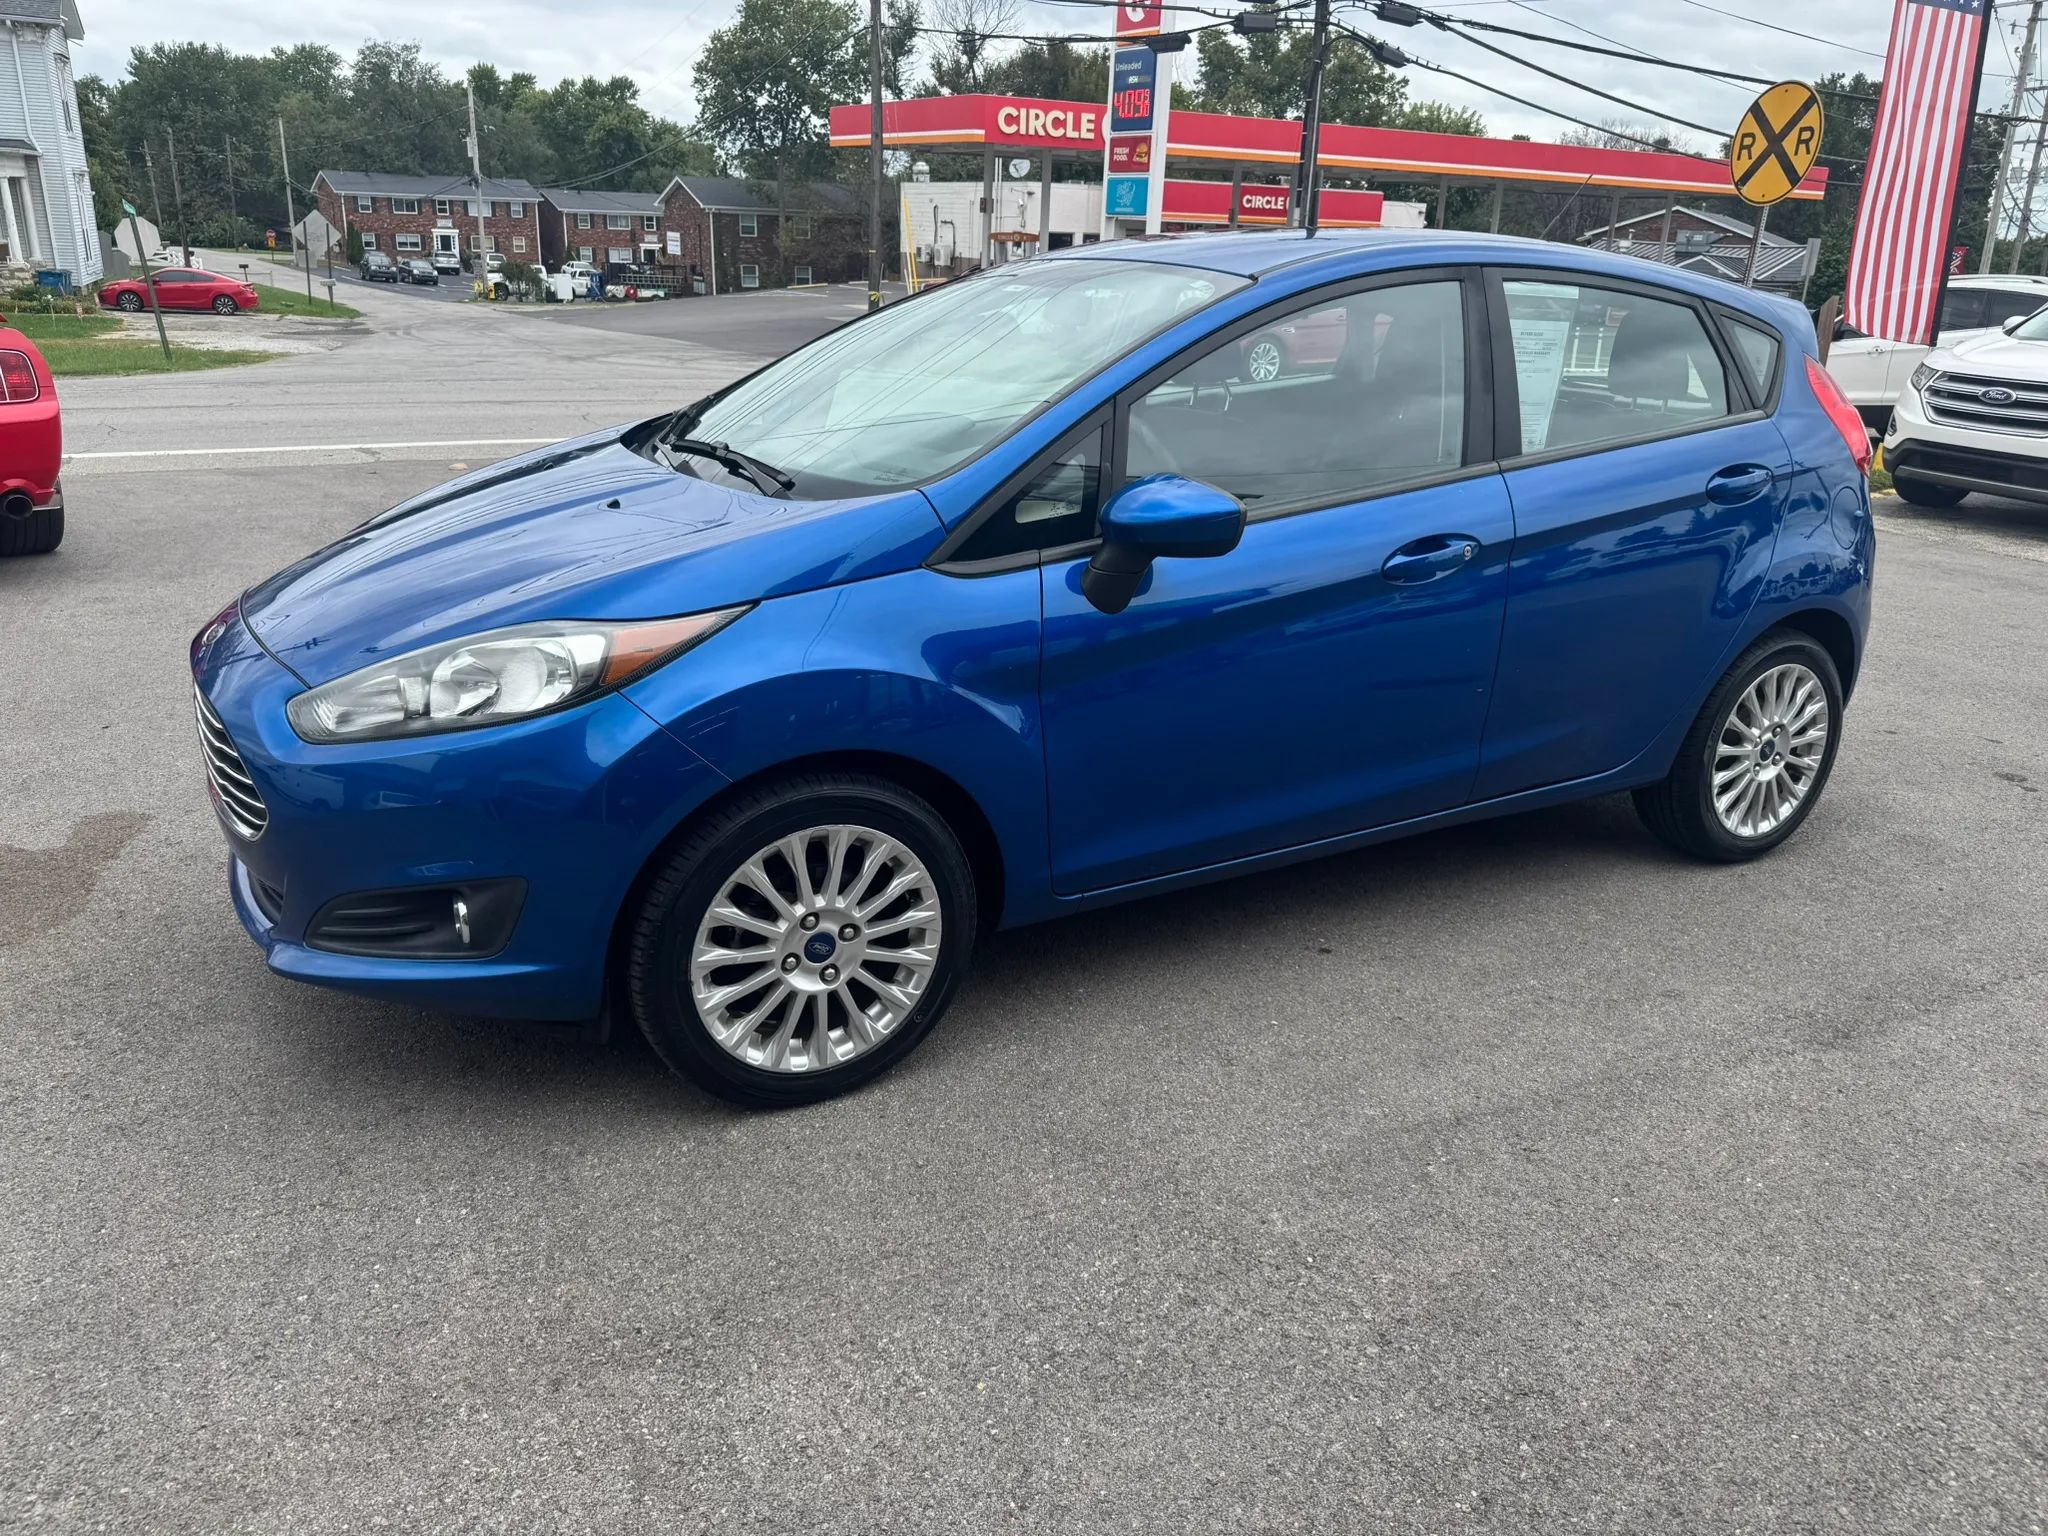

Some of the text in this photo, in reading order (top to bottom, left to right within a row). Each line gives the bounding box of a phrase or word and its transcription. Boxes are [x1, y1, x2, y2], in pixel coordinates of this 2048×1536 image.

[1115, 60, 1142, 71] Unleaded
[997, 106, 1096, 140] CIRCLE
[1736, 132, 1756, 161] R
[1794, 126, 1815, 156] R
[1113, 147, 1130, 155] FRESH
[1242, 195, 1285, 210] CIRCLE
[1985, 390, 2007, 400] Ford
